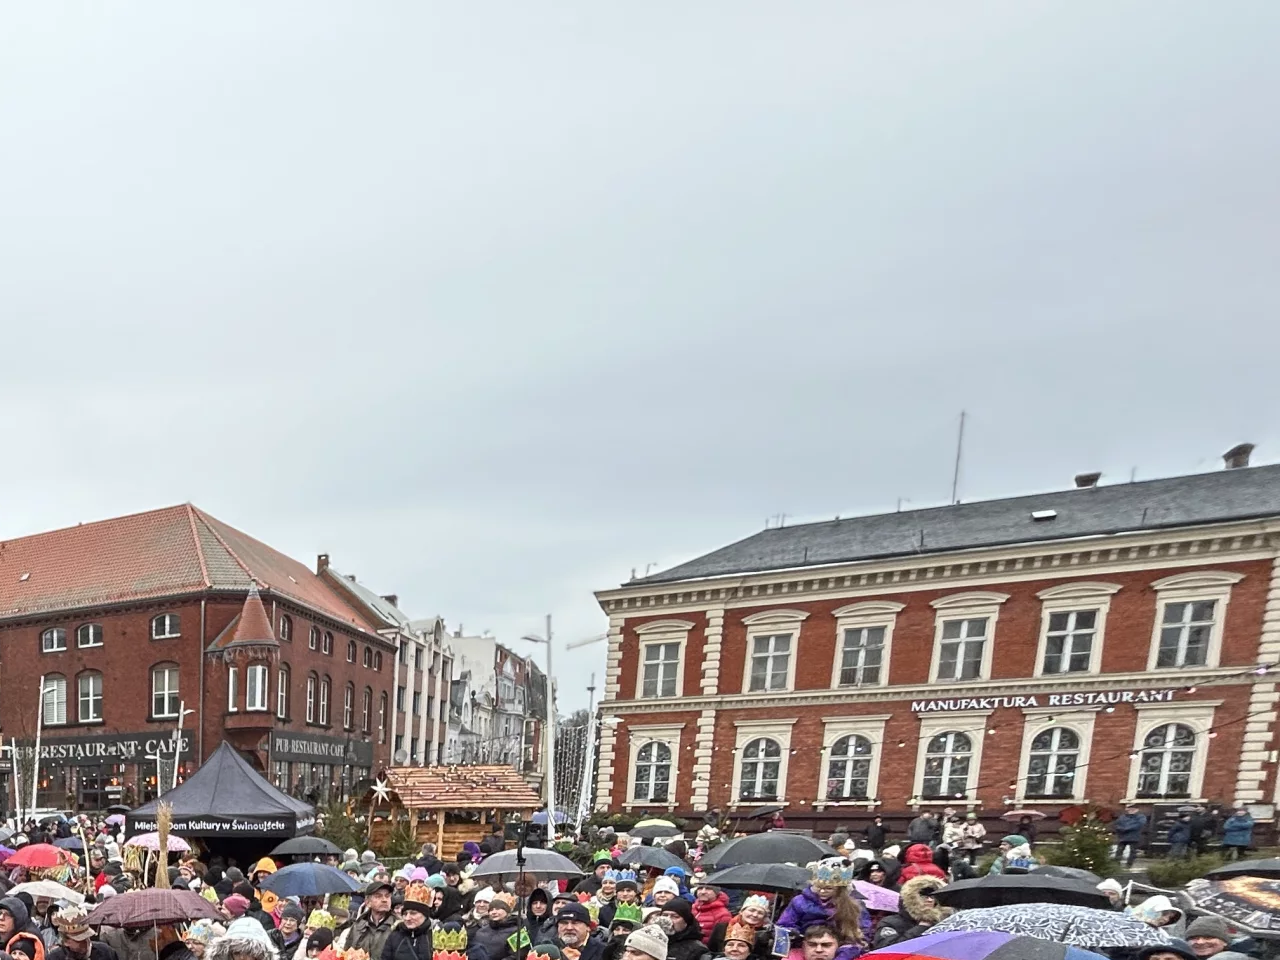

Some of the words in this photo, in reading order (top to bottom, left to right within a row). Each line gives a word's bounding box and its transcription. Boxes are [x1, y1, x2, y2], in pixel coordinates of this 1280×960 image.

[911, 697, 1038, 712] MANUFAKTURA
[1049, 688, 1175, 706] RESTAURANT
[40, 740, 139, 759] RESTAURANT
[145, 737, 189, 753] CAFE
[275, 738, 289, 752] PUB
[291, 740, 329, 756] RESTAURANT
[135, 822, 163, 831] Miejs
[189, 820, 220, 831] Kultury
[232, 819, 285, 831] Świnoujściu
